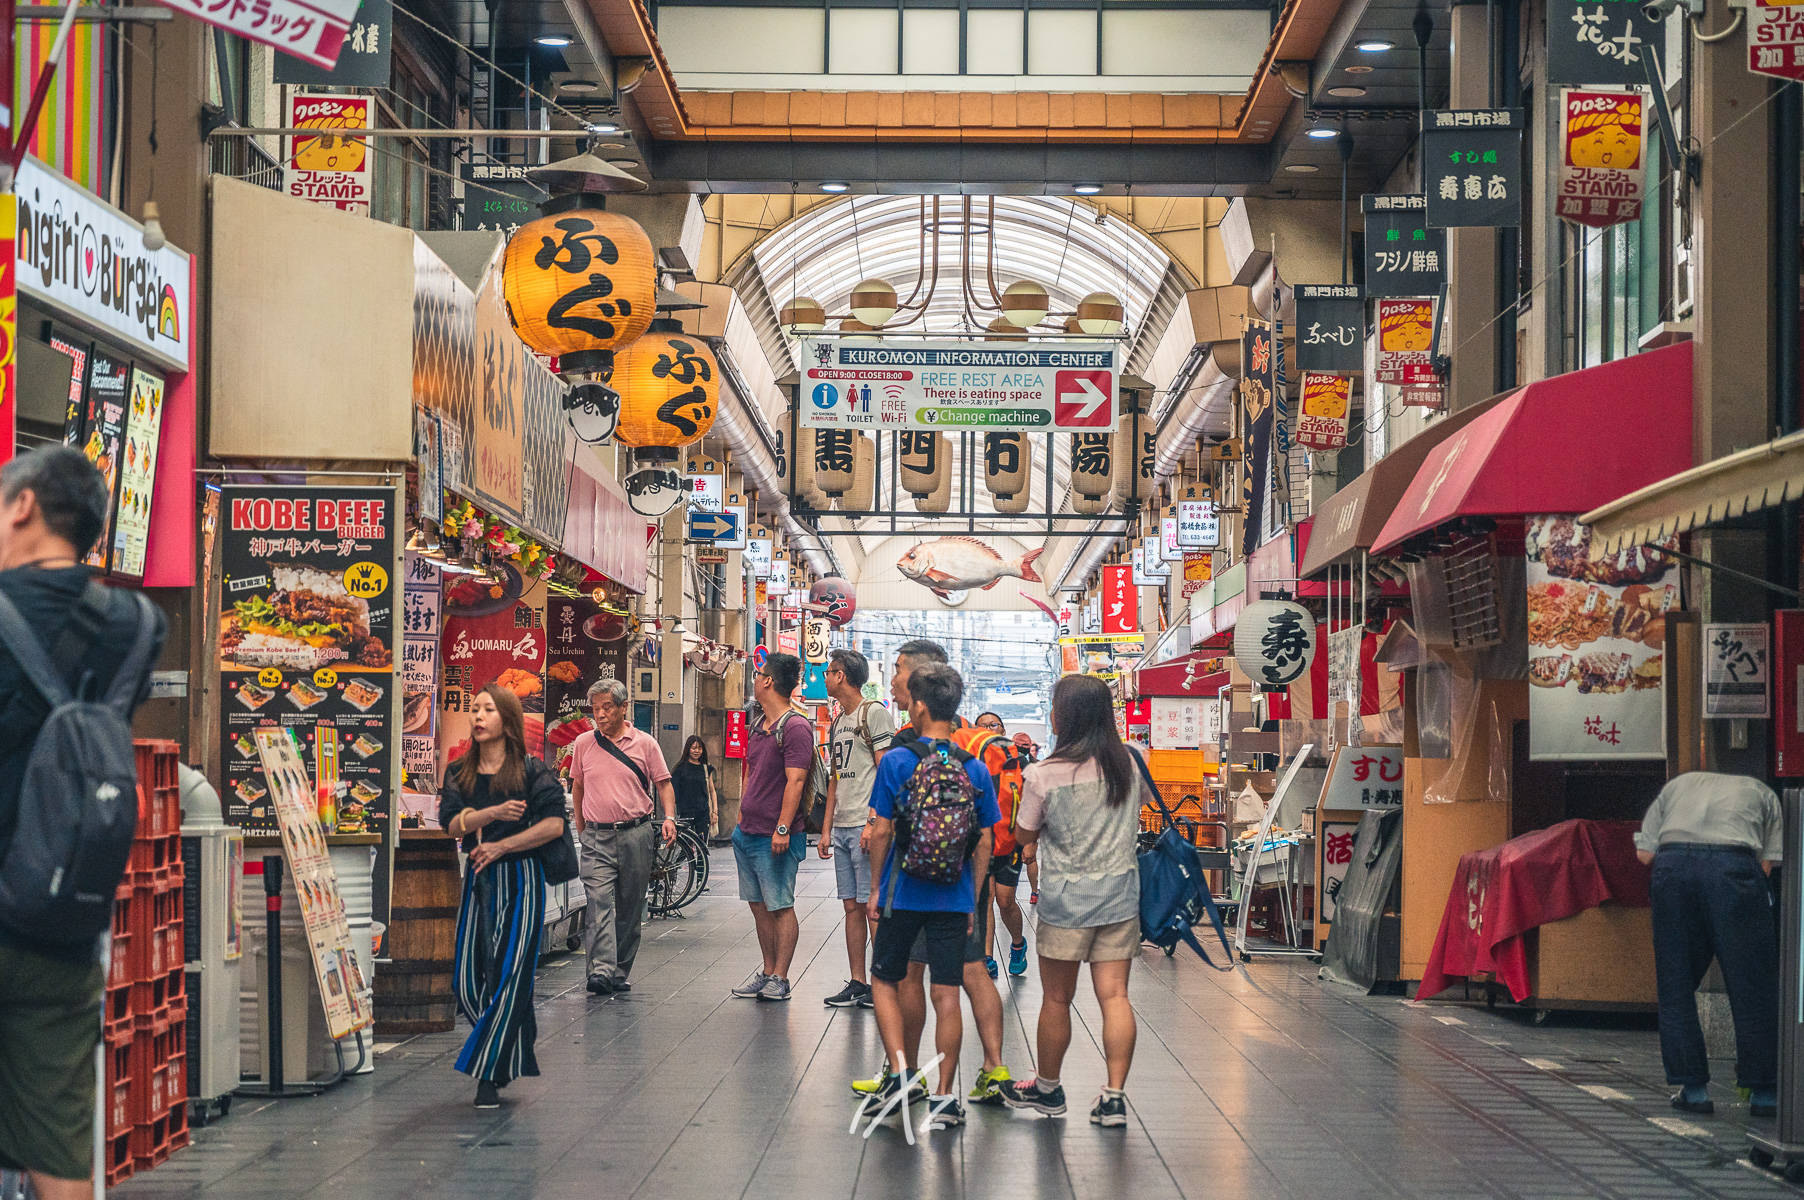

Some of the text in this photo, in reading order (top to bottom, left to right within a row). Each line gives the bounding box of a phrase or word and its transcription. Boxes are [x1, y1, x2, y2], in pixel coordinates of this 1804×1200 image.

[1571, 5, 1641, 65] 花の木
[295, 101, 343, 120] クロモン
[1569, 97, 1618, 115] クロモン
[1436, 111, 1511, 127] 黒門市場
[297, 170, 356, 185] フレッシュ
[1571, 167, 1631, 182] フレッシュ
[290, 182, 365, 199] STAMP
[1564, 180, 1638, 197] STAMP
[1374, 196, 1427, 209] 黒門市
[1563, 198, 1635, 217] 加盟店
[18, 187, 79, 289] nigiri
[1374, 250, 1439, 272] フジノ鮮魚
[535, 217, 632, 339] ふぐ
[1304, 286, 1358, 297] 黒門市場
[1381, 303, 1415, 316] クロモン
[849, 350, 1103, 366] KUROMON INFORMATION CENTER
[1384, 351, 1426, 360] フレッシュ
[818, 371, 838, 379] OPEN
[839, 371, 856, 379] 9:00
[921, 372, 1044, 387] FREE REST AREA
[1306, 375, 1336, 385] クロモン
[652, 339, 711, 437] ふぐ
[923, 388, 1042, 402] There is eating space
[881, 401, 906, 411] FREE
[881, 413, 907, 423] Wi-Fi
[939, 410, 986, 424] Change
[988, 410, 1040, 423] machine
[1304, 415, 1340, 427] フレッシュ
[1300, 422, 1344, 435] STAMP
[1299, 433, 1343, 446] 加盟店
[231, 498, 385, 532] KOBE BEEF
[338, 525, 385, 539] BURGER
[249, 537, 372, 557] 神戸牛バーガー
[350, 578, 382, 592] No.1
[534, 606, 544, 629] Tuna
[471, 639, 513, 651] UOMARU
[549, 646, 585, 655] Sea Urchin
[597, 647, 618, 656] Tuna
[445, 665, 462, 713] 雲丹
[463, 665, 474, 713] Sea Urchin
[1583, 714, 1622, 746] 花の木
[1351, 754, 1403, 783] すし
